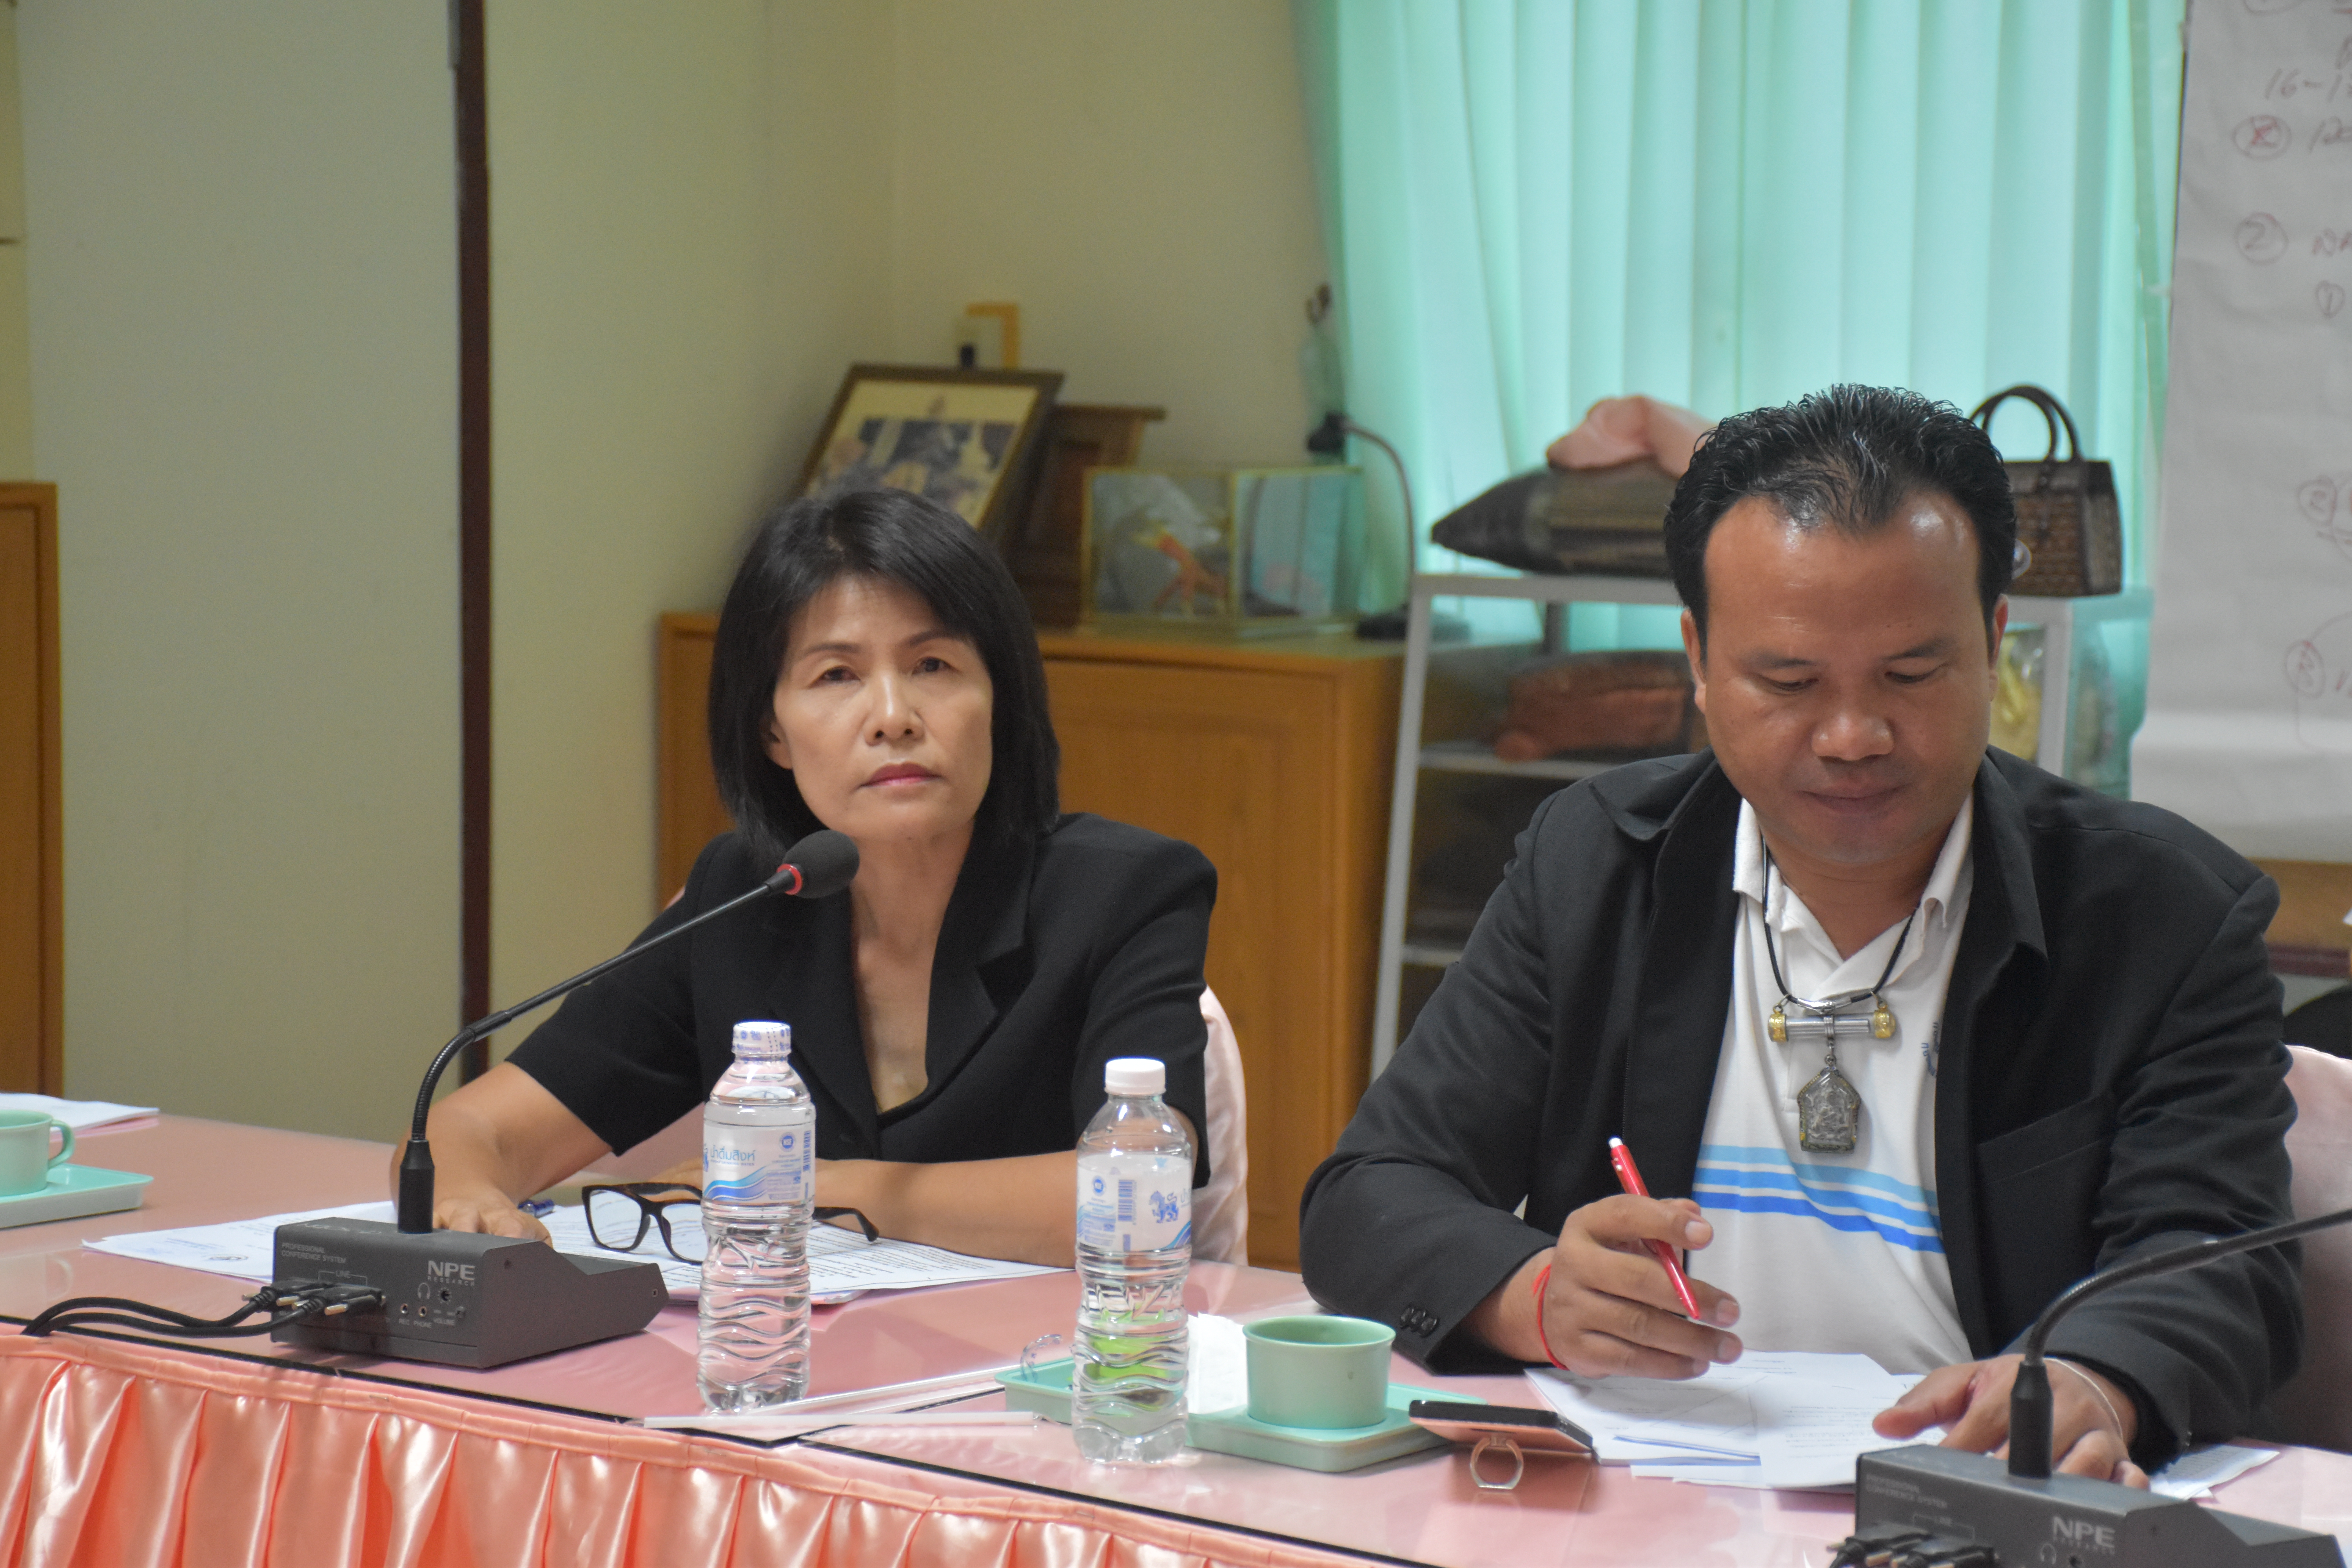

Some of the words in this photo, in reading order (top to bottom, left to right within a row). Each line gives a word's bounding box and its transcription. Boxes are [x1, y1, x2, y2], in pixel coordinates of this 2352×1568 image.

[322, 1255, 347, 1263] SYSTEM
[428, 1260, 475, 1281] NPE
[427, 1276, 475, 1287] RESEARCH
[2053, 1516, 2116, 1548] NPE
